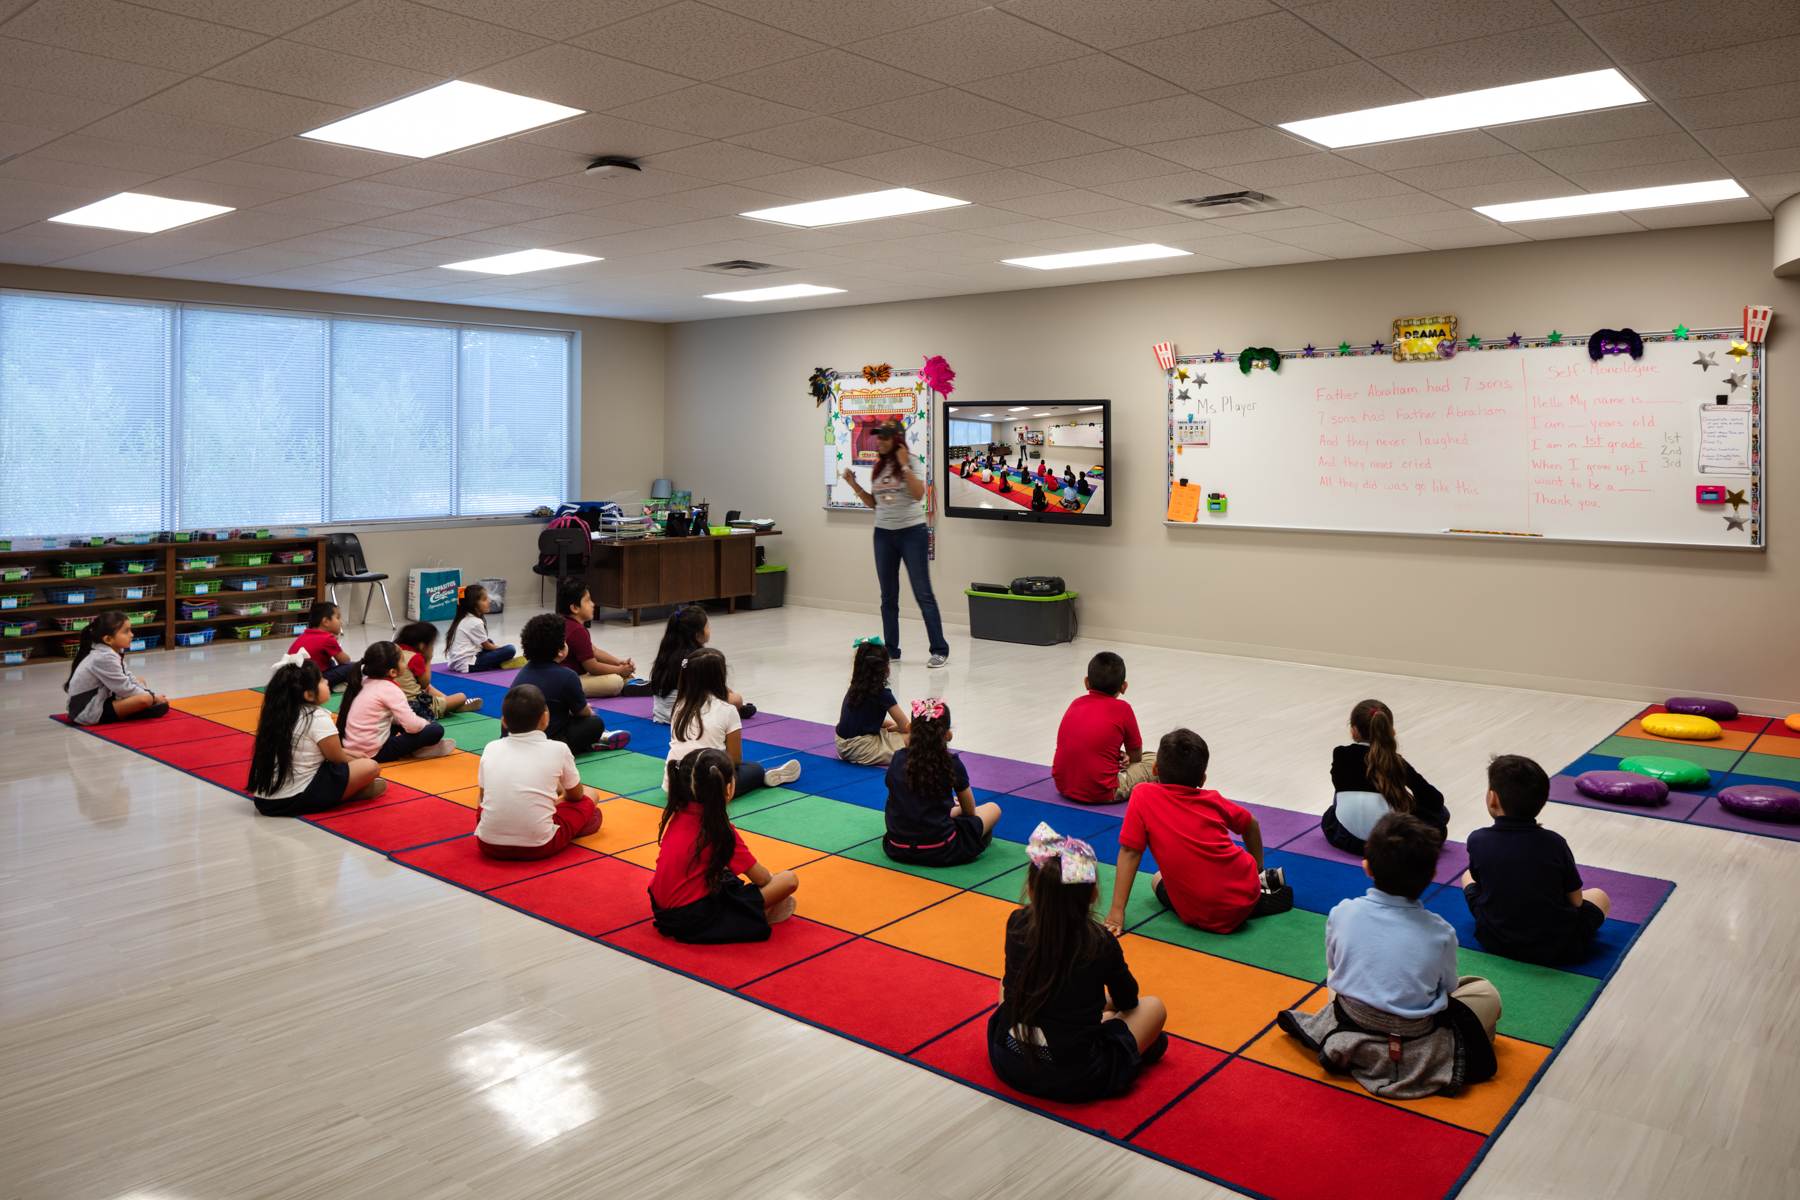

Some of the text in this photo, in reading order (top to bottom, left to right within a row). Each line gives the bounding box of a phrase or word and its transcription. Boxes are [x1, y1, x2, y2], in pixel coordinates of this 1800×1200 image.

[1404, 329, 1447, 340] DRAMA
[1315, 386, 1360, 401] Father
[1368, 380, 1418, 398] Abraham
[1425, 376, 1450, 393] had
[1463, 376, 1472, 392] 7
[1222, 395, 1258, 417] Player
[1569, 393, 1588, 413] My
[1593, 397, 1625, 406] name
[1318, 403, 1506, 425] 7 sons had Father Abraham
[1530, 415, 1656, 432] I am years old
[1319, 430, 1470, 451] And they never laughed
[1530, 434, 1644, 455] I am in 1st grade
[1663, 431, 1681, 443] 1st
[1660, 444, 1682, 456] 2nd
[1318, 455, 1337, 467] And
[1344, 455, 1365, 470] they
[1401, 456, 1433, 470] cried
[1530, 458, 1562, 471] When
[1568, 458, 1580, 472] I
[1586, 462, 1612, 476] grow
[1637, 459, 1649, 473] I
[1662, 457, 1682, 469] 3rd
[1319, 475, 1333, 487] All
[1339, 475, 1359, 494] they
[1362, 478, 1378, 491] did
[1383, 482, 1410, 491] was
[1415, 482, 1426, 496] go
[1433, 479, 1451, 493] like
[1534, 476, 1564, 486] want
[1570, 477, 1582, 489] to
[1588, 478, 1601, 491] be
[1534, 491, 1572, 505] Thank
